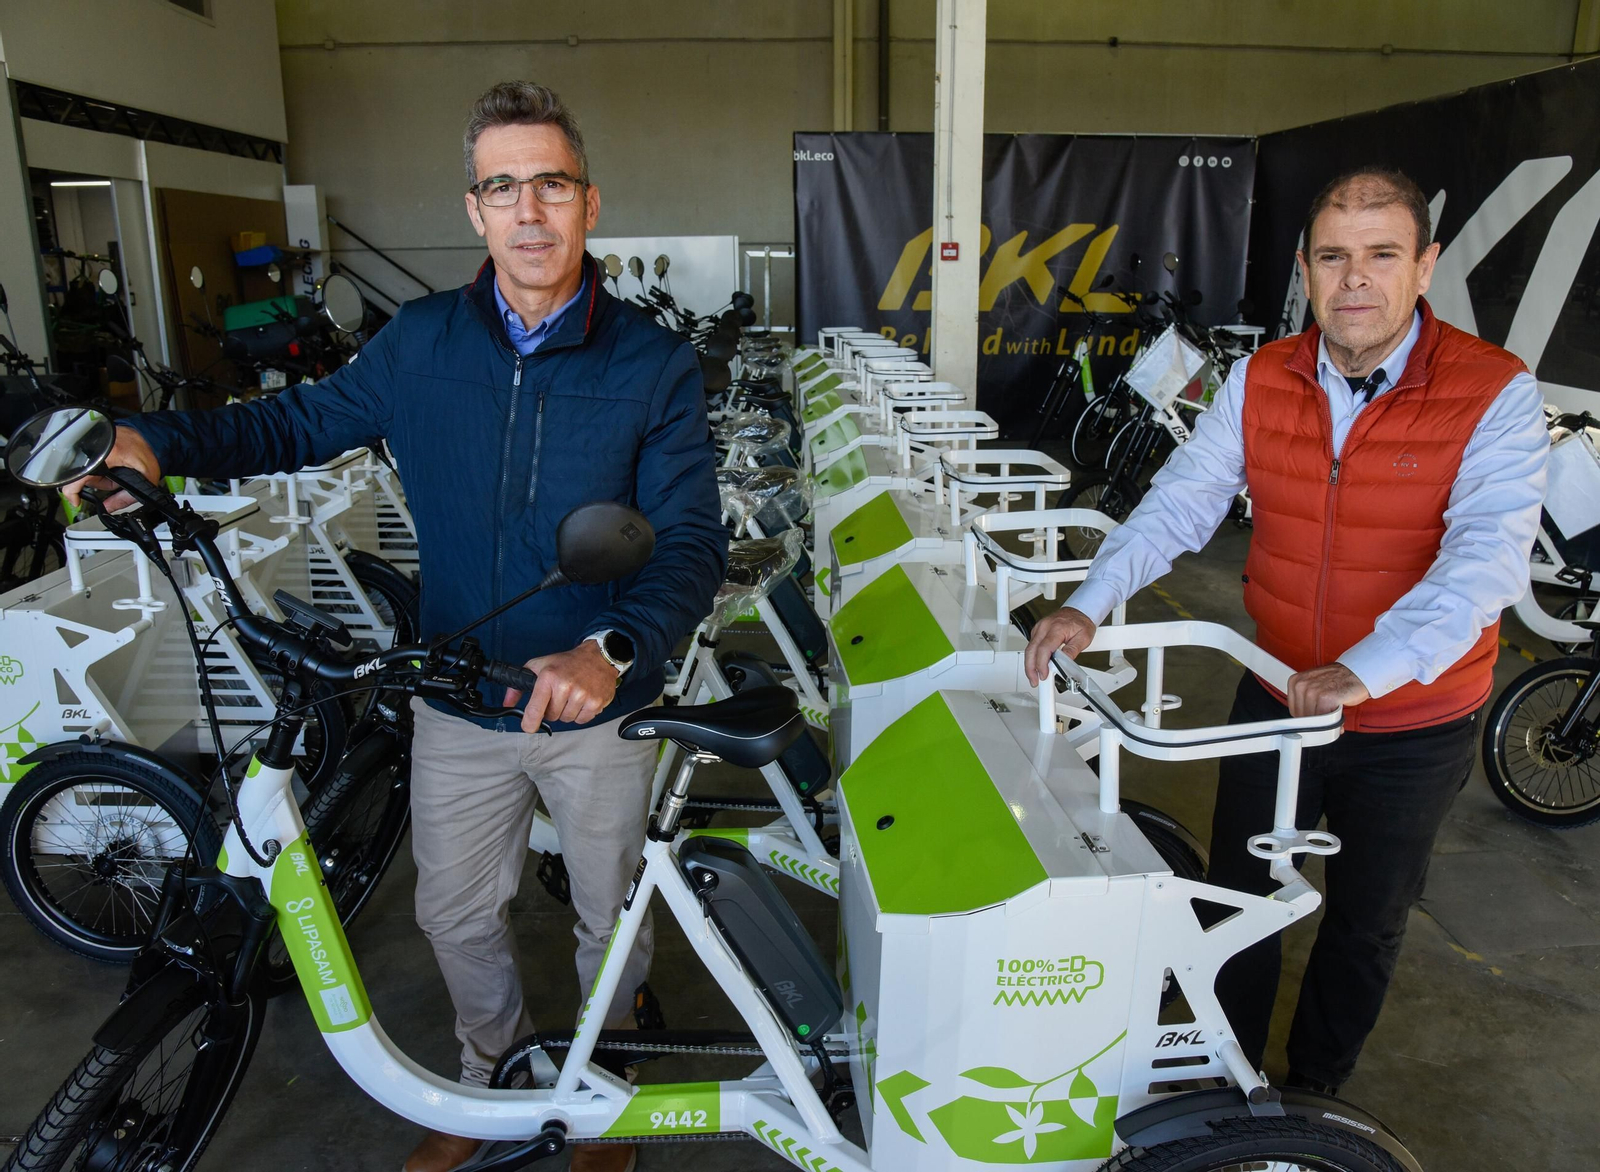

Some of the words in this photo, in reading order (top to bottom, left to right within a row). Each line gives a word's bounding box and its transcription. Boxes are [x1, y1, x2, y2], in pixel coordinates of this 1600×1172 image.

[793, 150, 835, 161] bkl.eco
[1006, 338, 1051, 355] with
[353, 657, 387, 679] BKL
[62, 708, 92, 719] BKL
[289, 852, 310, 877] BKL
[297, 914, 338, 985] LIPASAM
[996, 958, 1055, 973] 100%
[996, 973, 1087, 987] ELÉCTRICO
[773, 980, 804, 1010] BKL
[1155, 1029, 1206, 1048] BKL
[650, 1109, 708, 1130] 9442
